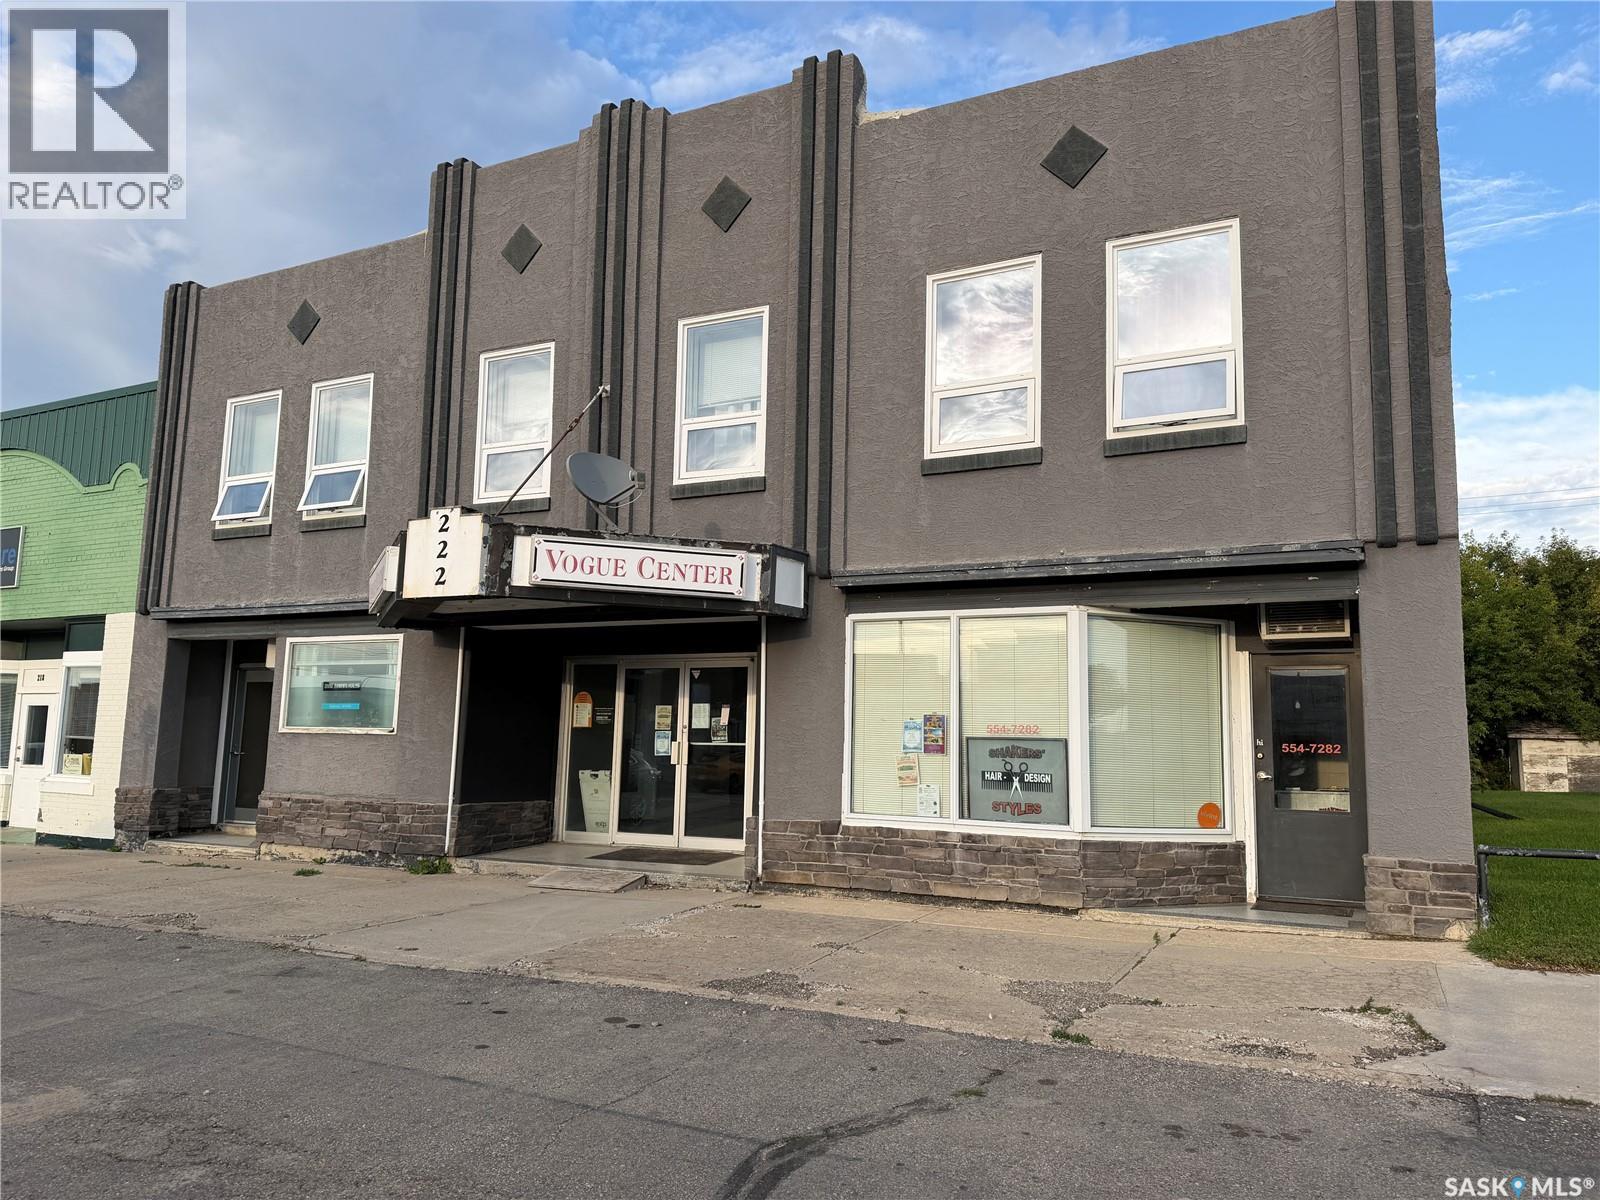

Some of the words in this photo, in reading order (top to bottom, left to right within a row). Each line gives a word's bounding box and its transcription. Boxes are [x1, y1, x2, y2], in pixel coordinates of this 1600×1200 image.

[986, 724, 1040, 735] 554-7282
[1281, 743, 1342, 754] 554-7282
[1024, 773, 1051, 783] DESIGN
[991, 801, 1042, 816] STYLES
